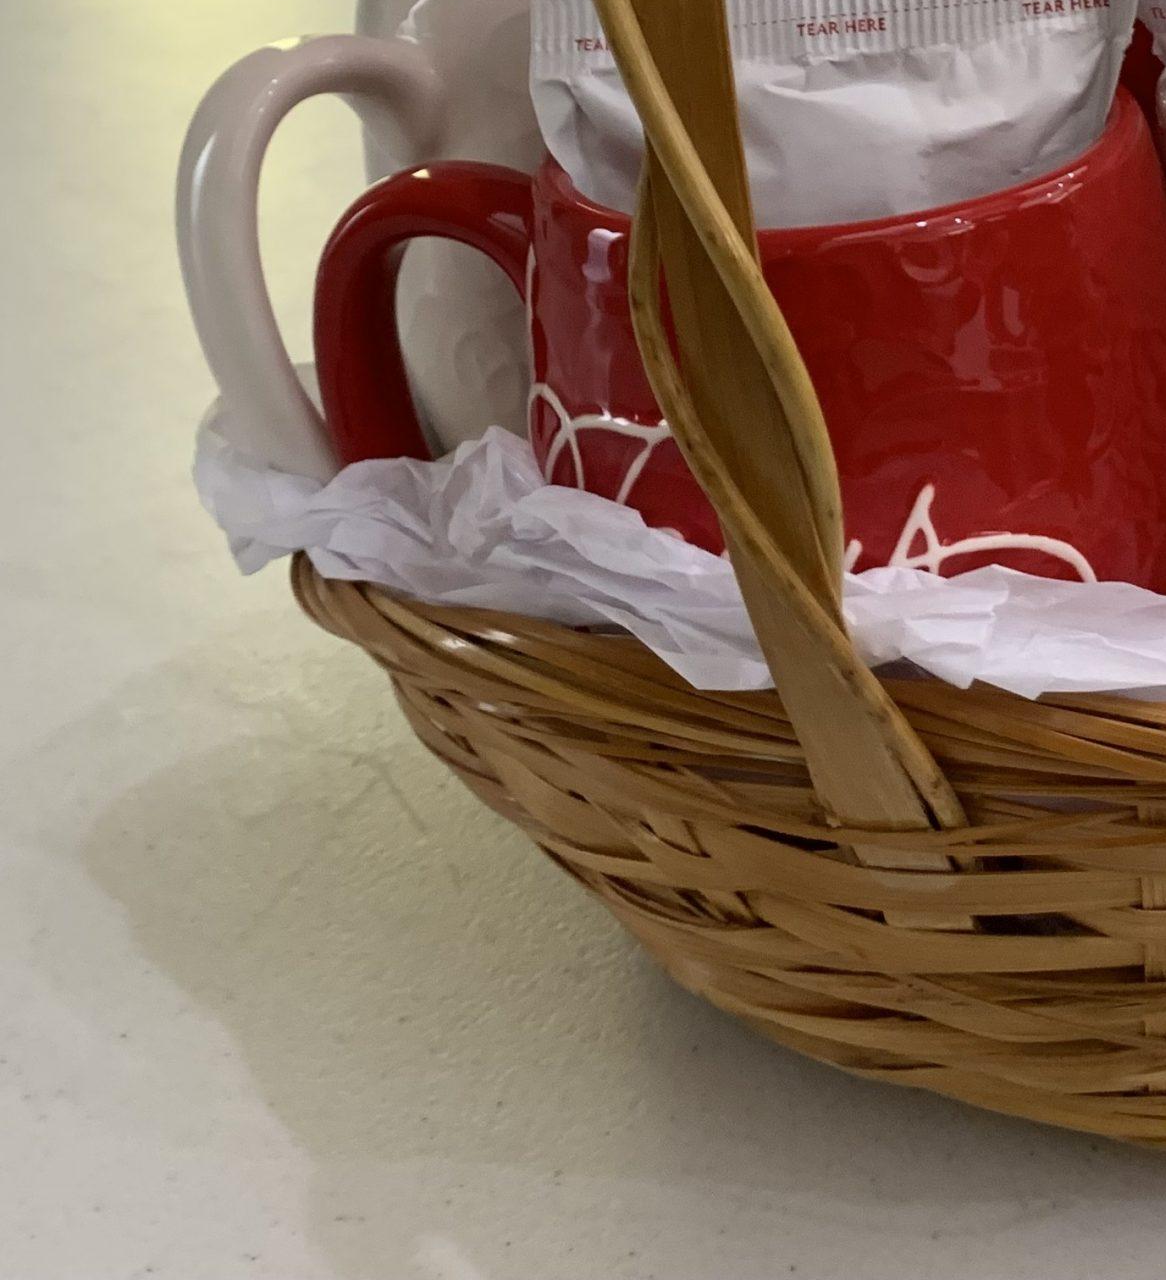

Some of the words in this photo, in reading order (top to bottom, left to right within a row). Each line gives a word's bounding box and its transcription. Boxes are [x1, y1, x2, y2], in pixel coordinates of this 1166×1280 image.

[1022, 0, 1065, 15] TEAR
[796, 21, 840, 37] TEAR
[844, 17, 886, 33] HERE
